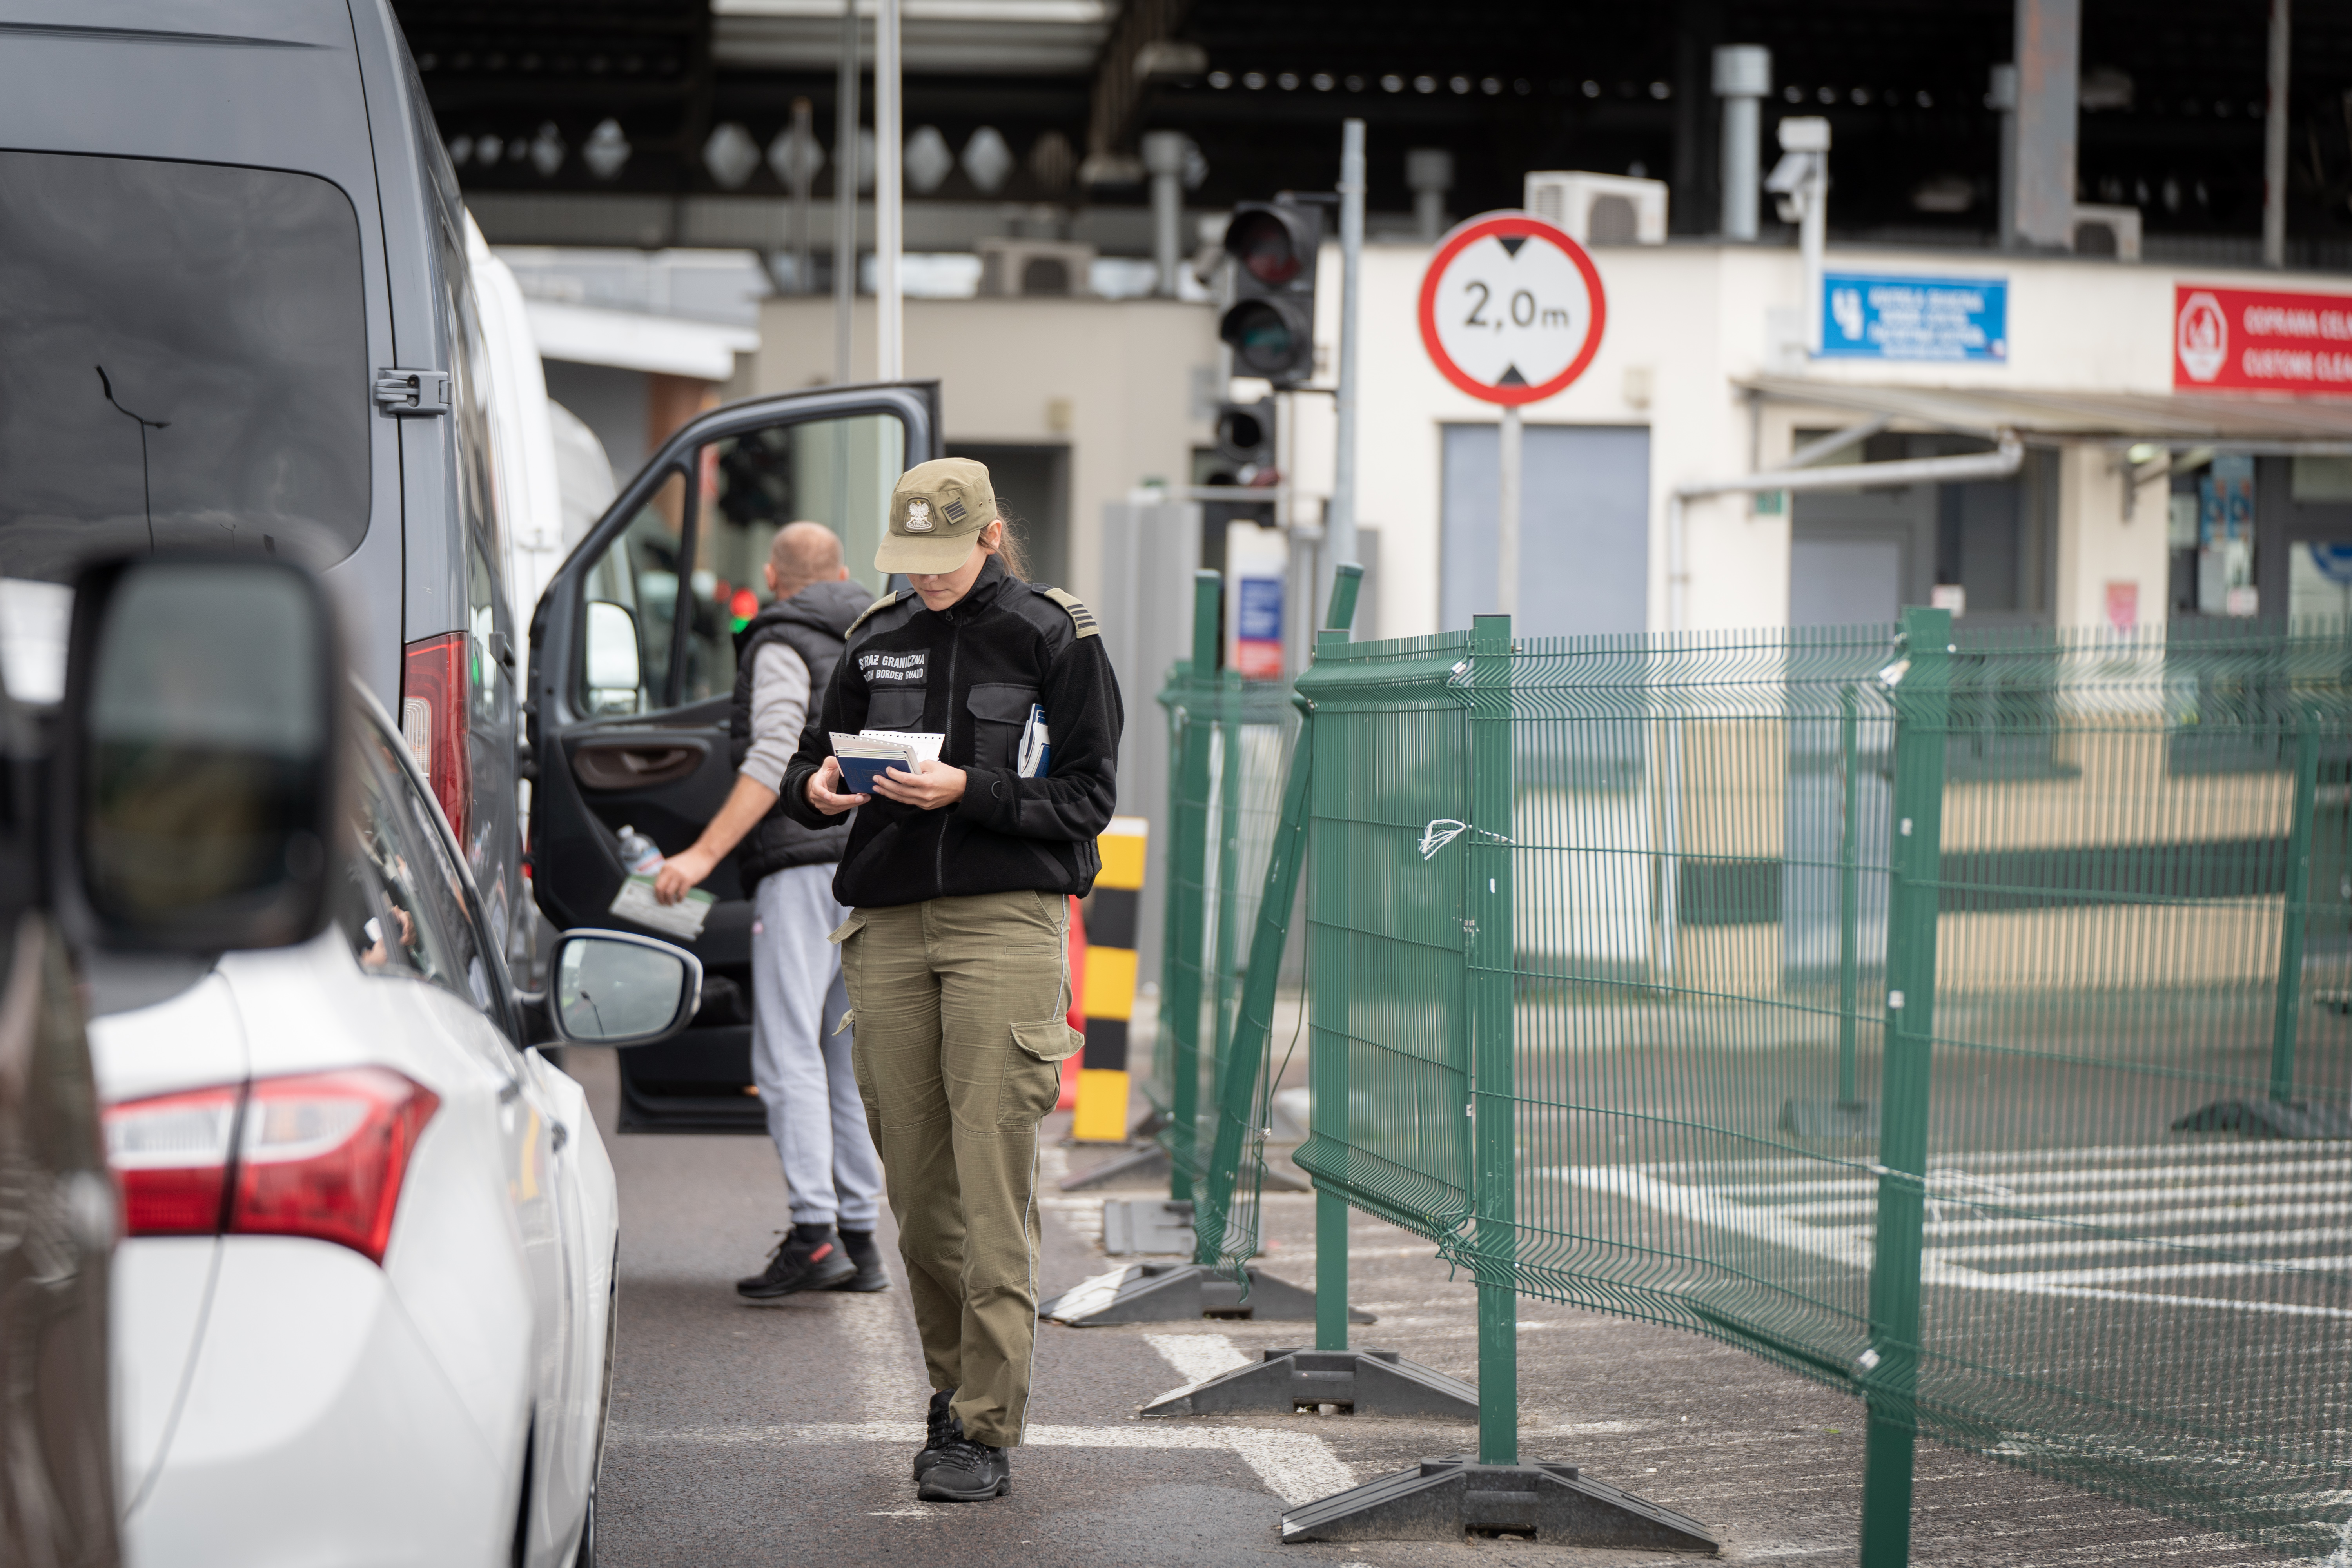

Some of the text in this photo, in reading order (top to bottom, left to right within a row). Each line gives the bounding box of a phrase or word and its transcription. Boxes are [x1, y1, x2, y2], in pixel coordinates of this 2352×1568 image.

[859, 654, 924, 670] STRAŻ GRANICZNA
[876, 669, 903, 680] BORDER
[905, 668, 923, 680] GUARD
